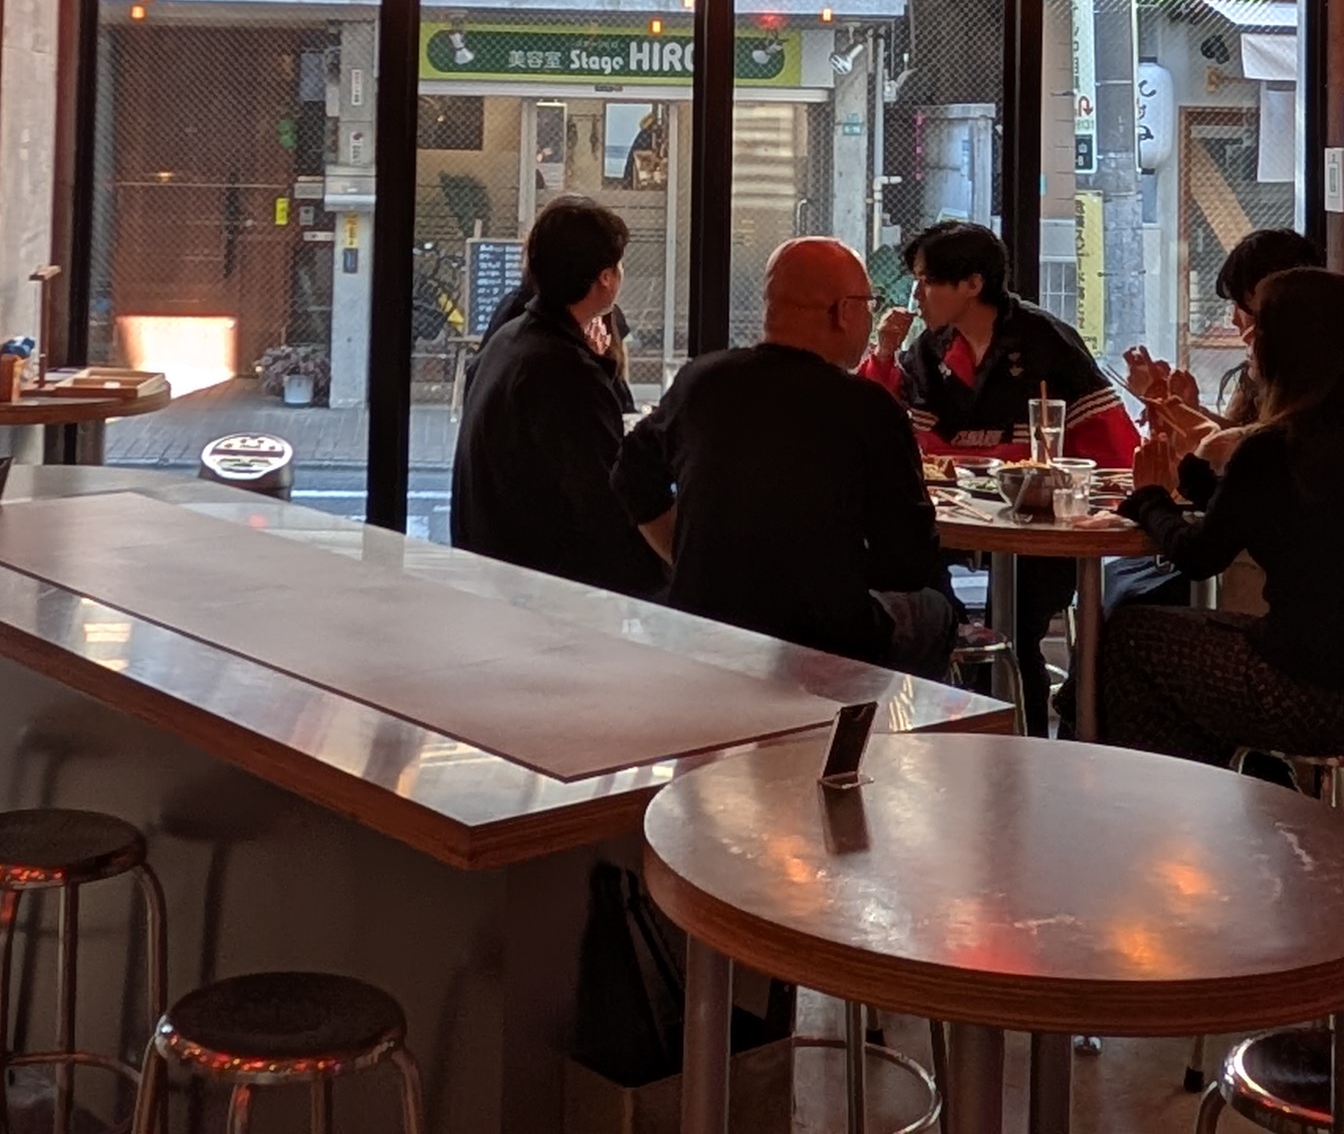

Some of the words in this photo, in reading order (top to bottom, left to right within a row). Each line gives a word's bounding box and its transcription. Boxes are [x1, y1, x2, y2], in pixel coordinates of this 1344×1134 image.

[508, 50, 563, 69] 美容室
[569, 49, 624, 74] Stage
